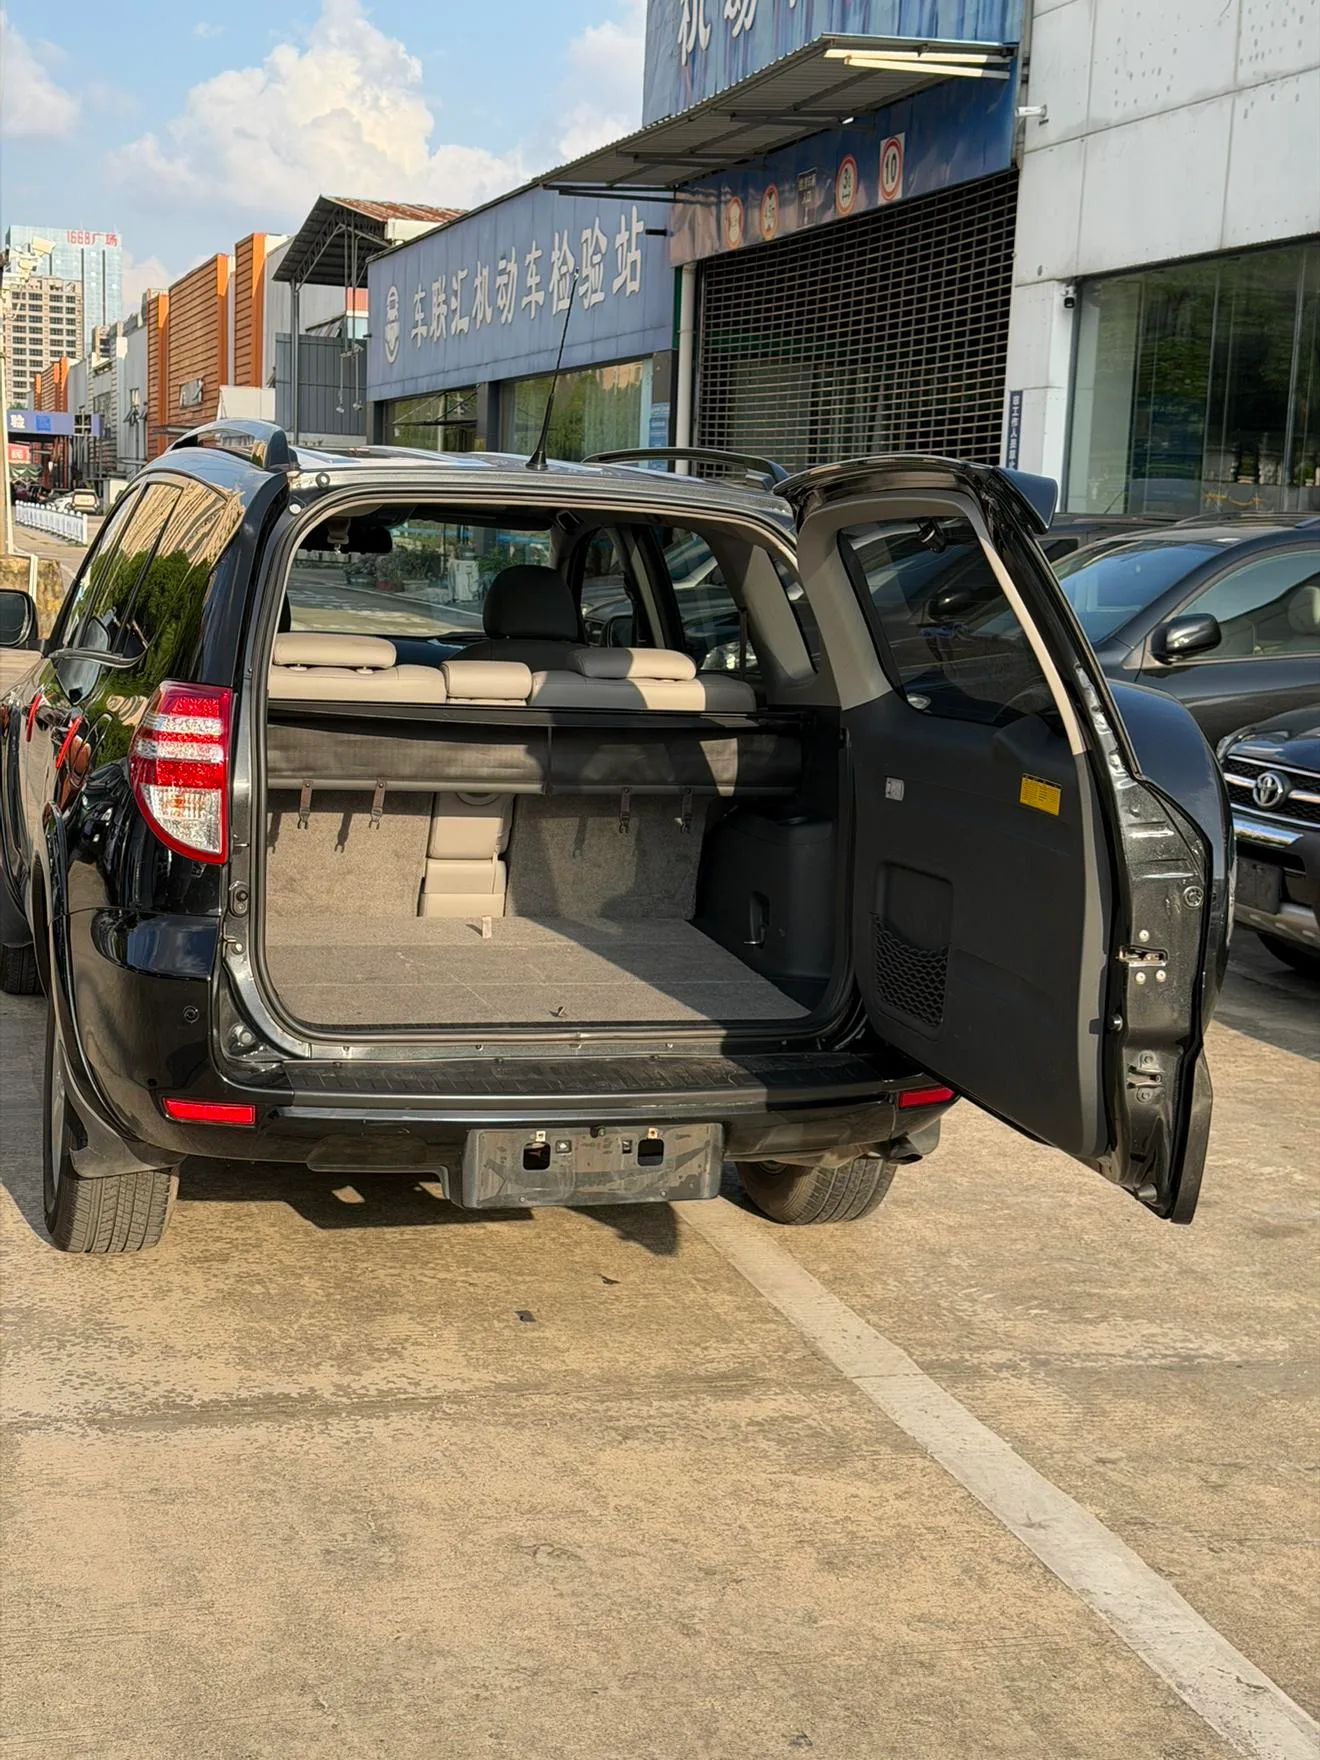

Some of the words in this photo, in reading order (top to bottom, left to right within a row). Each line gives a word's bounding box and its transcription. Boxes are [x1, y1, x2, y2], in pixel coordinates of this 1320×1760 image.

[885, 153, 896, 185] 10
[411, 205, 644, 348] 车联汇机动车检验站
